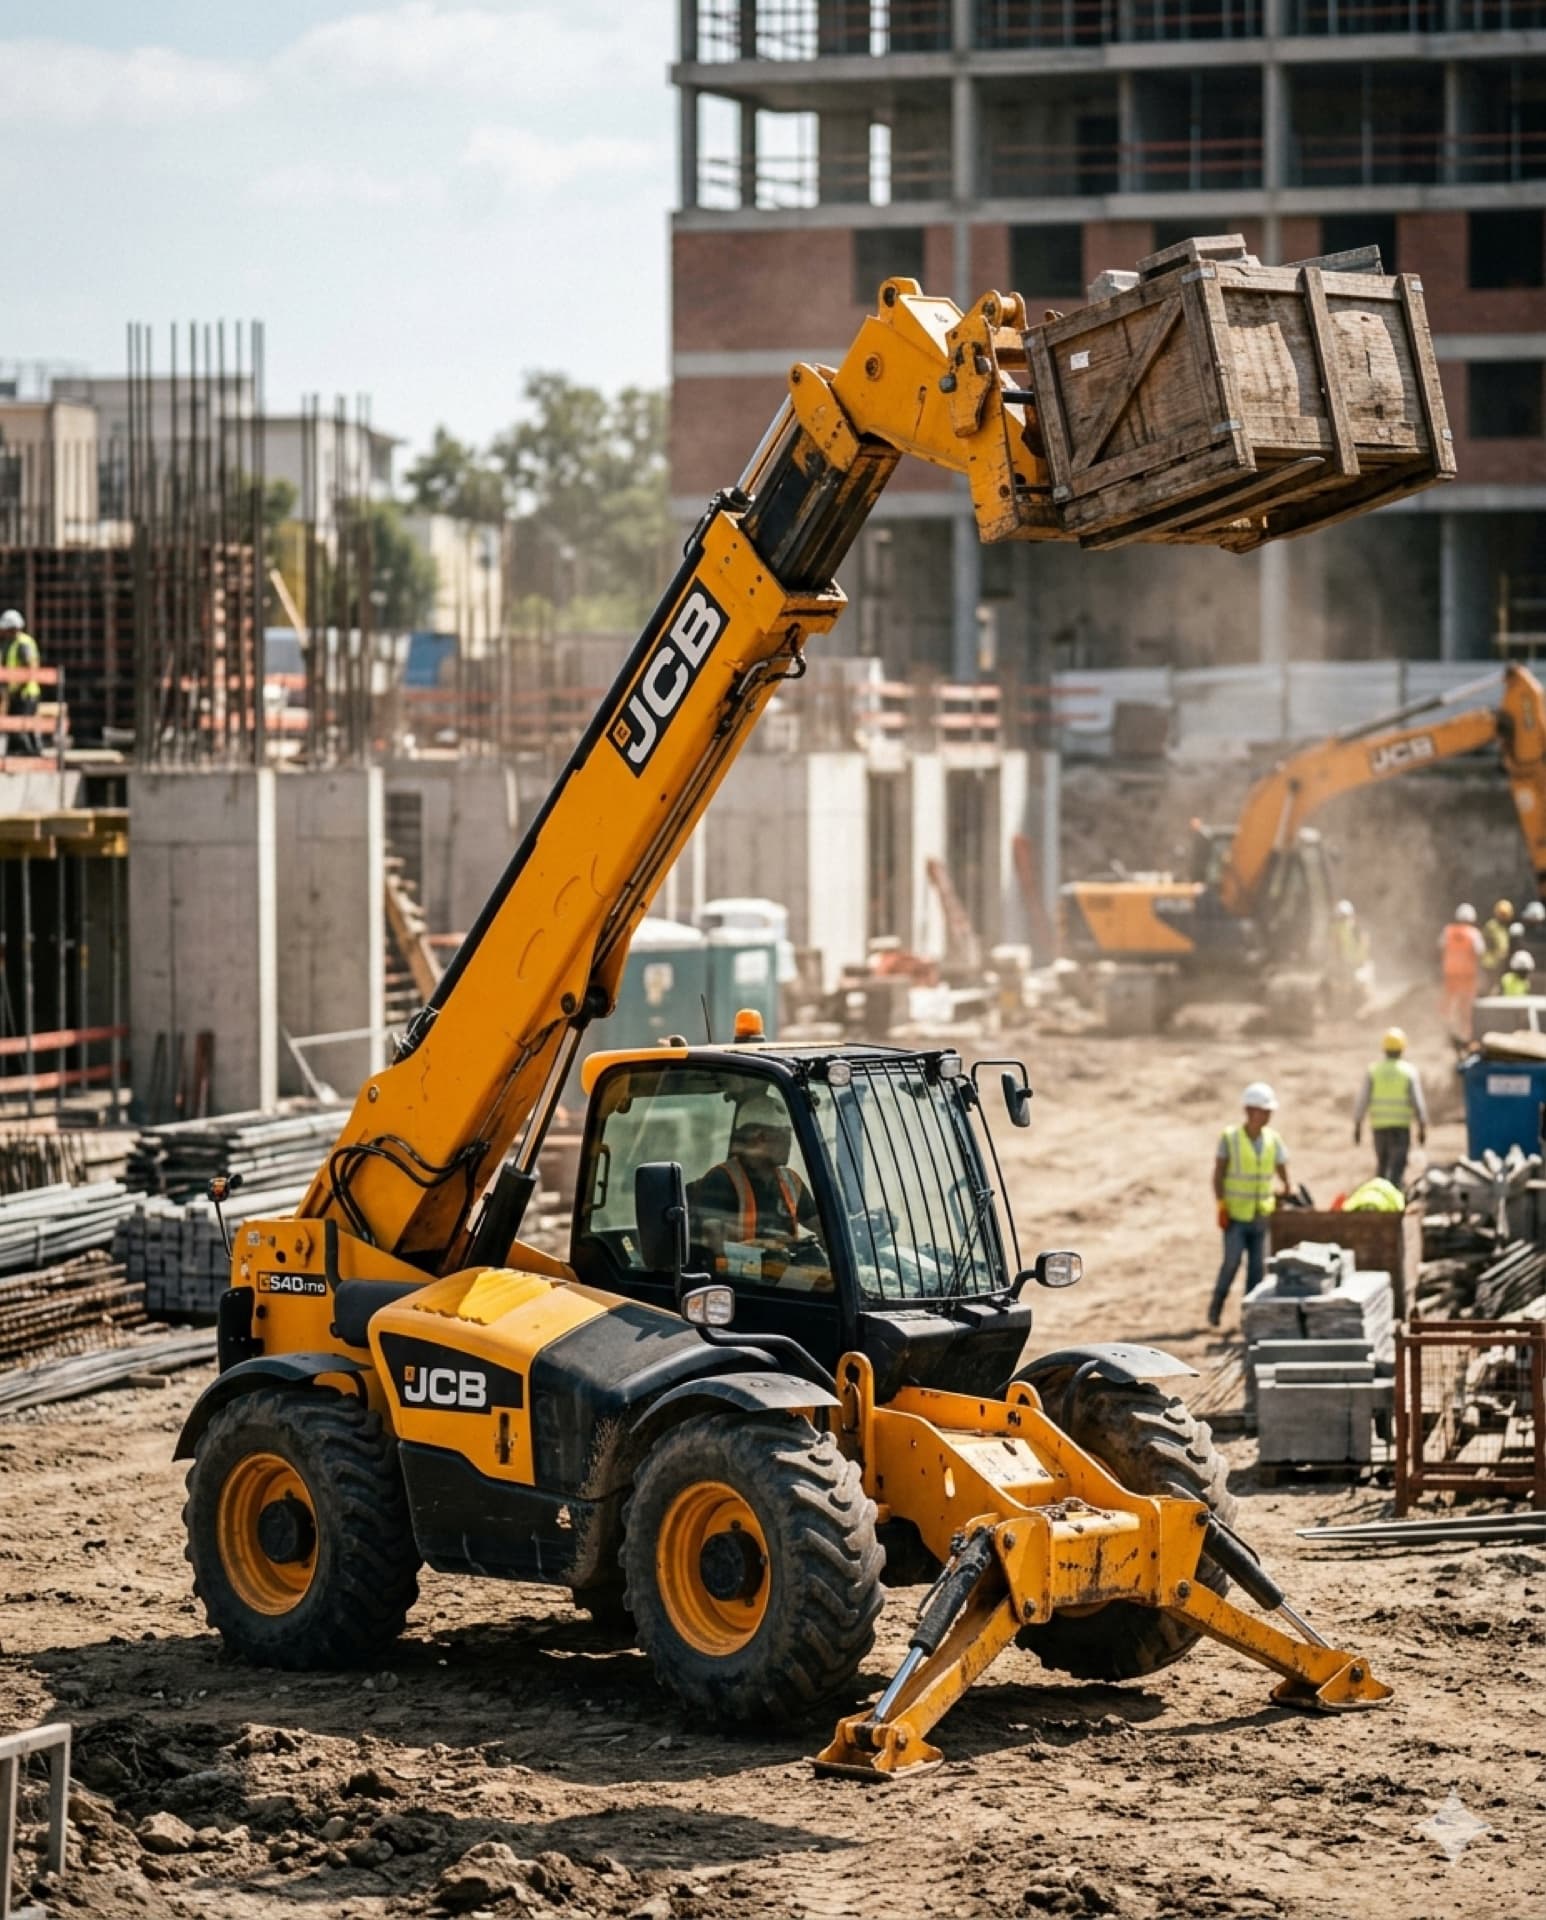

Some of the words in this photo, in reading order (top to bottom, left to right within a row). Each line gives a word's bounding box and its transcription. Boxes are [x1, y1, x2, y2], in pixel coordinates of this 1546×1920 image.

[627, 592, 721, 763] JCB
[1372, 736, 1433, 773] JCB
[404, 1366, 487, 1408] JCB
